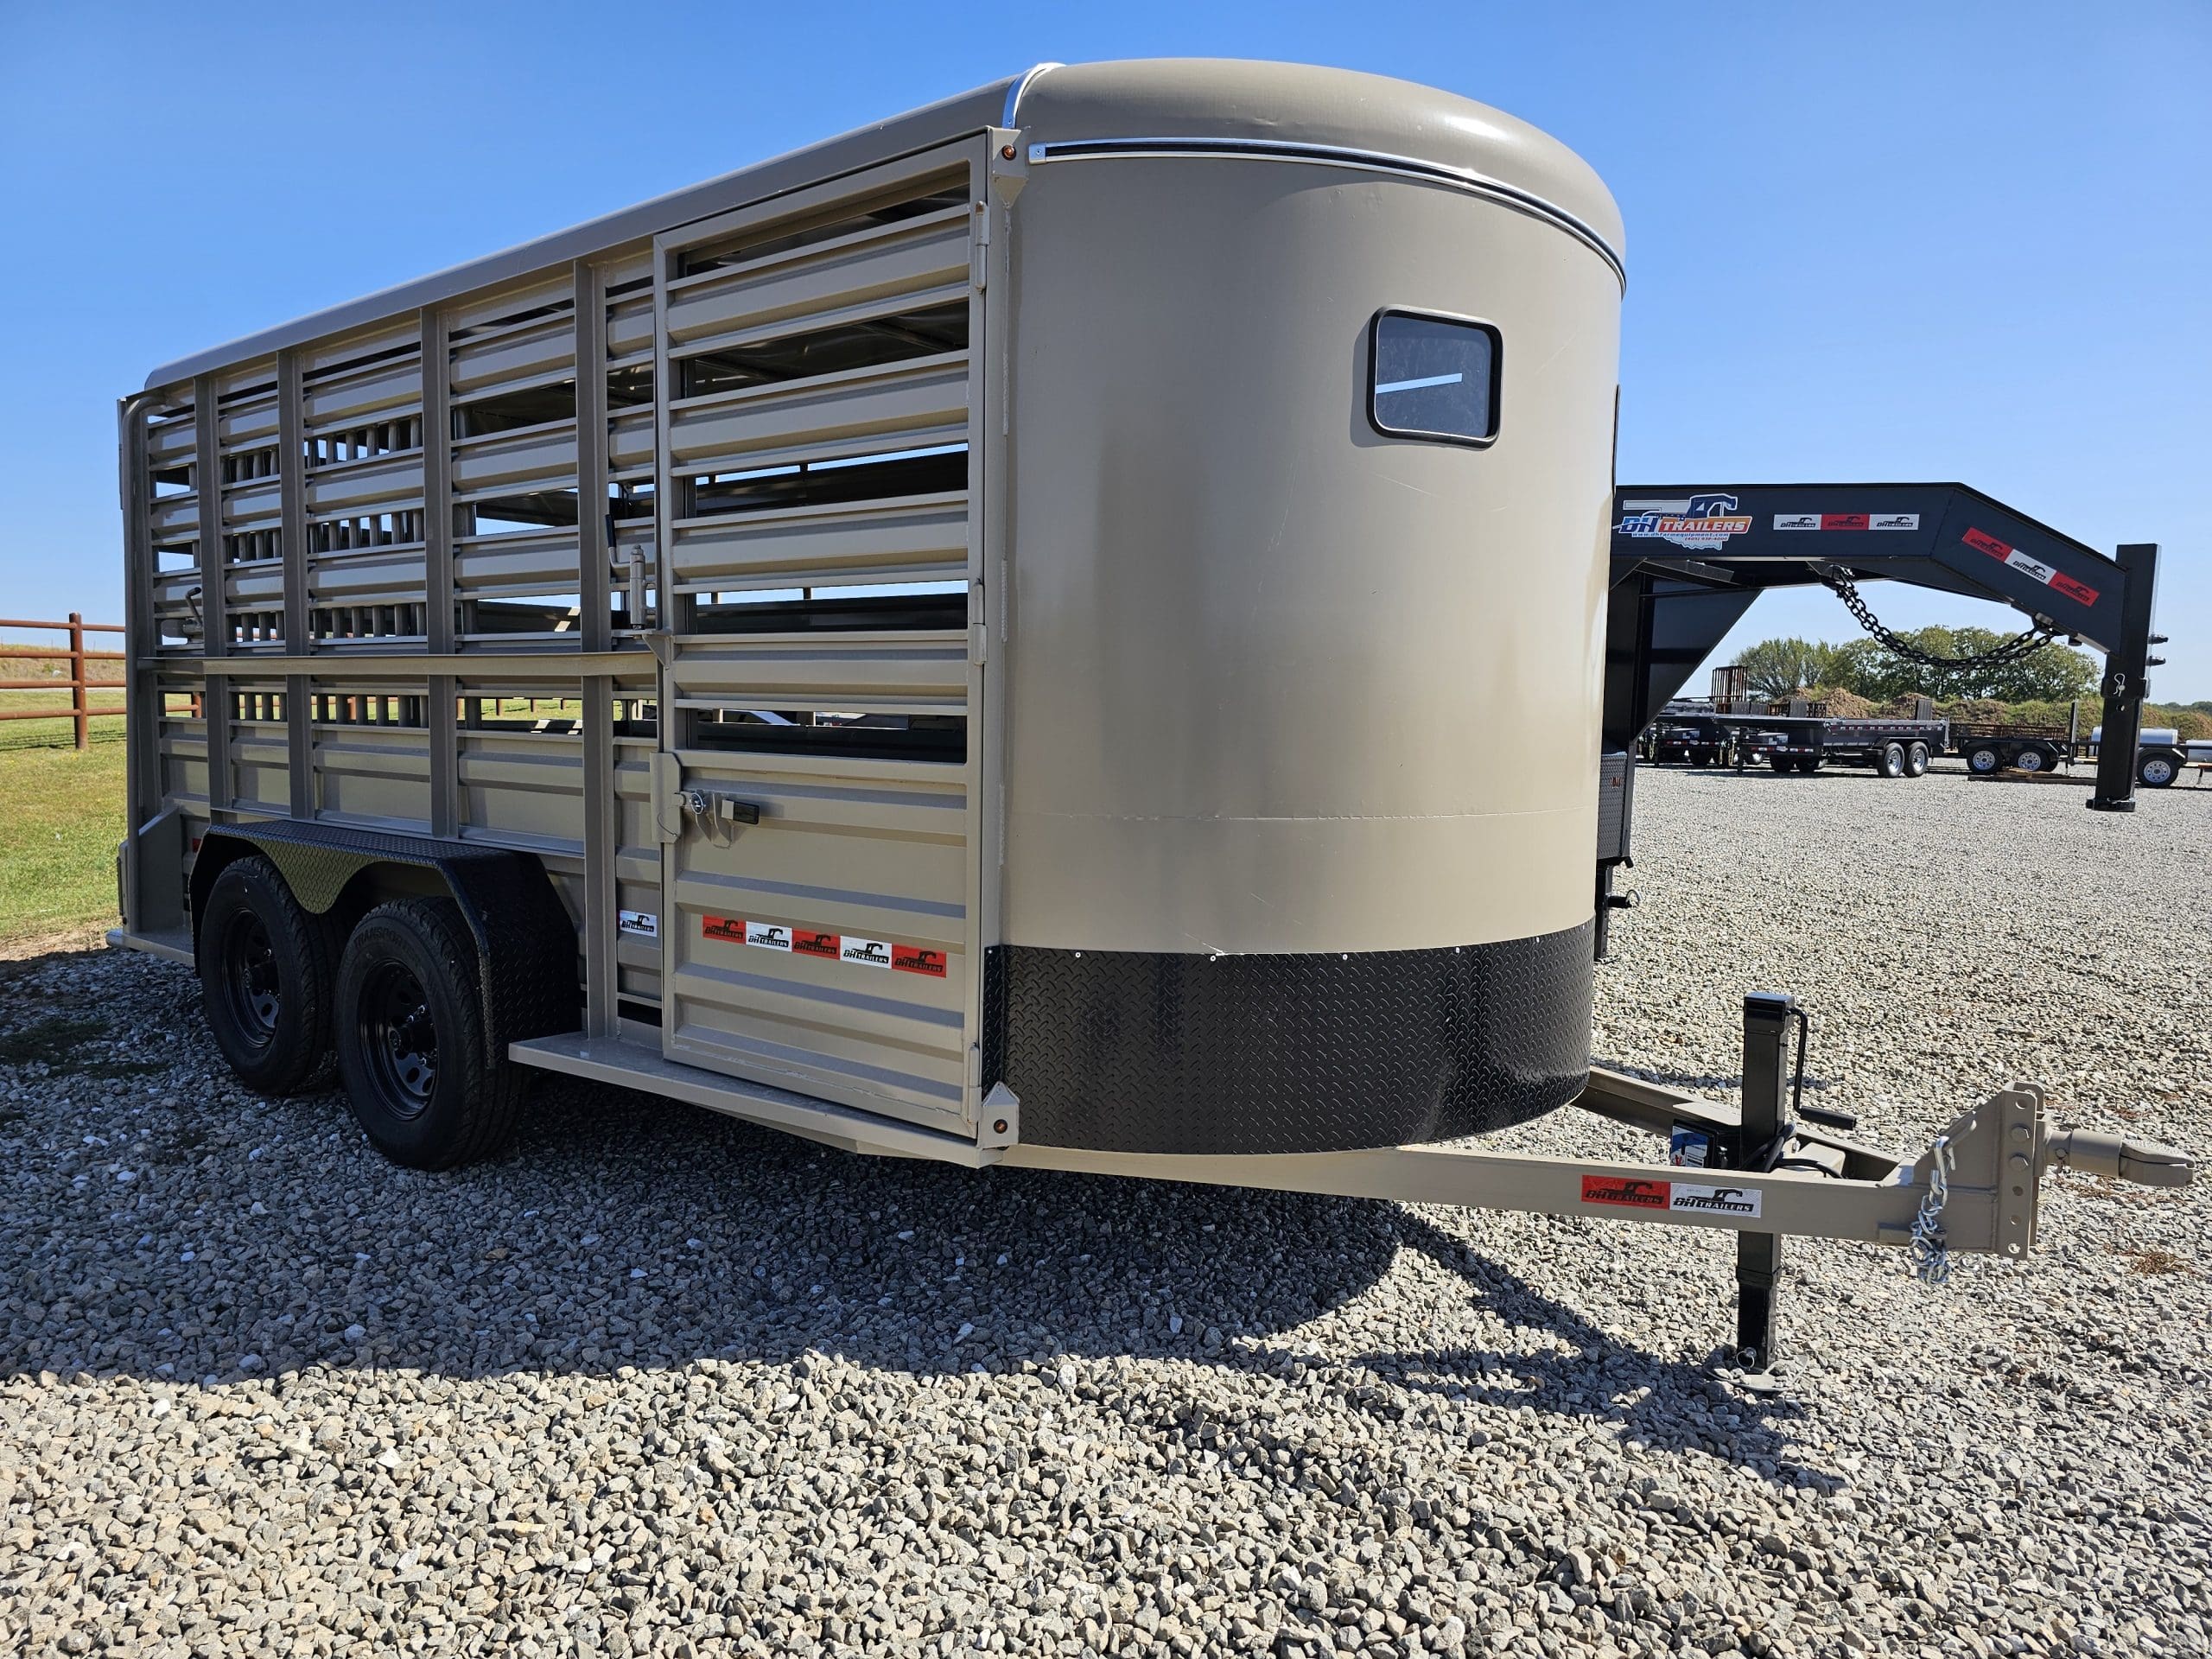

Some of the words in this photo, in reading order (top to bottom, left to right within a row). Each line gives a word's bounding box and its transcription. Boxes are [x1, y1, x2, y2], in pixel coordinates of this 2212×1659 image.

[1620, 516, 1657, 532] DH
[1663, 521, 1746, 531] TRAILERS
[748, 935, 760, 944] DH
[760, 938, 789, 948] TRAILERS
[807, 943, 837, 955] TRAILERS
[843, 950, 856, 958] DH
[856, 954, 889, 963] TRAILERS
[909, 962, 944, 973] TRAILERS
[1586, 1190, 1608, 1199] DH
[1609, 1193, 1664, 1205] TRAILERS
[1673, 1198, 1696, 1207] DH
[1699, 1201, 1753, 1212] TRAILERS
